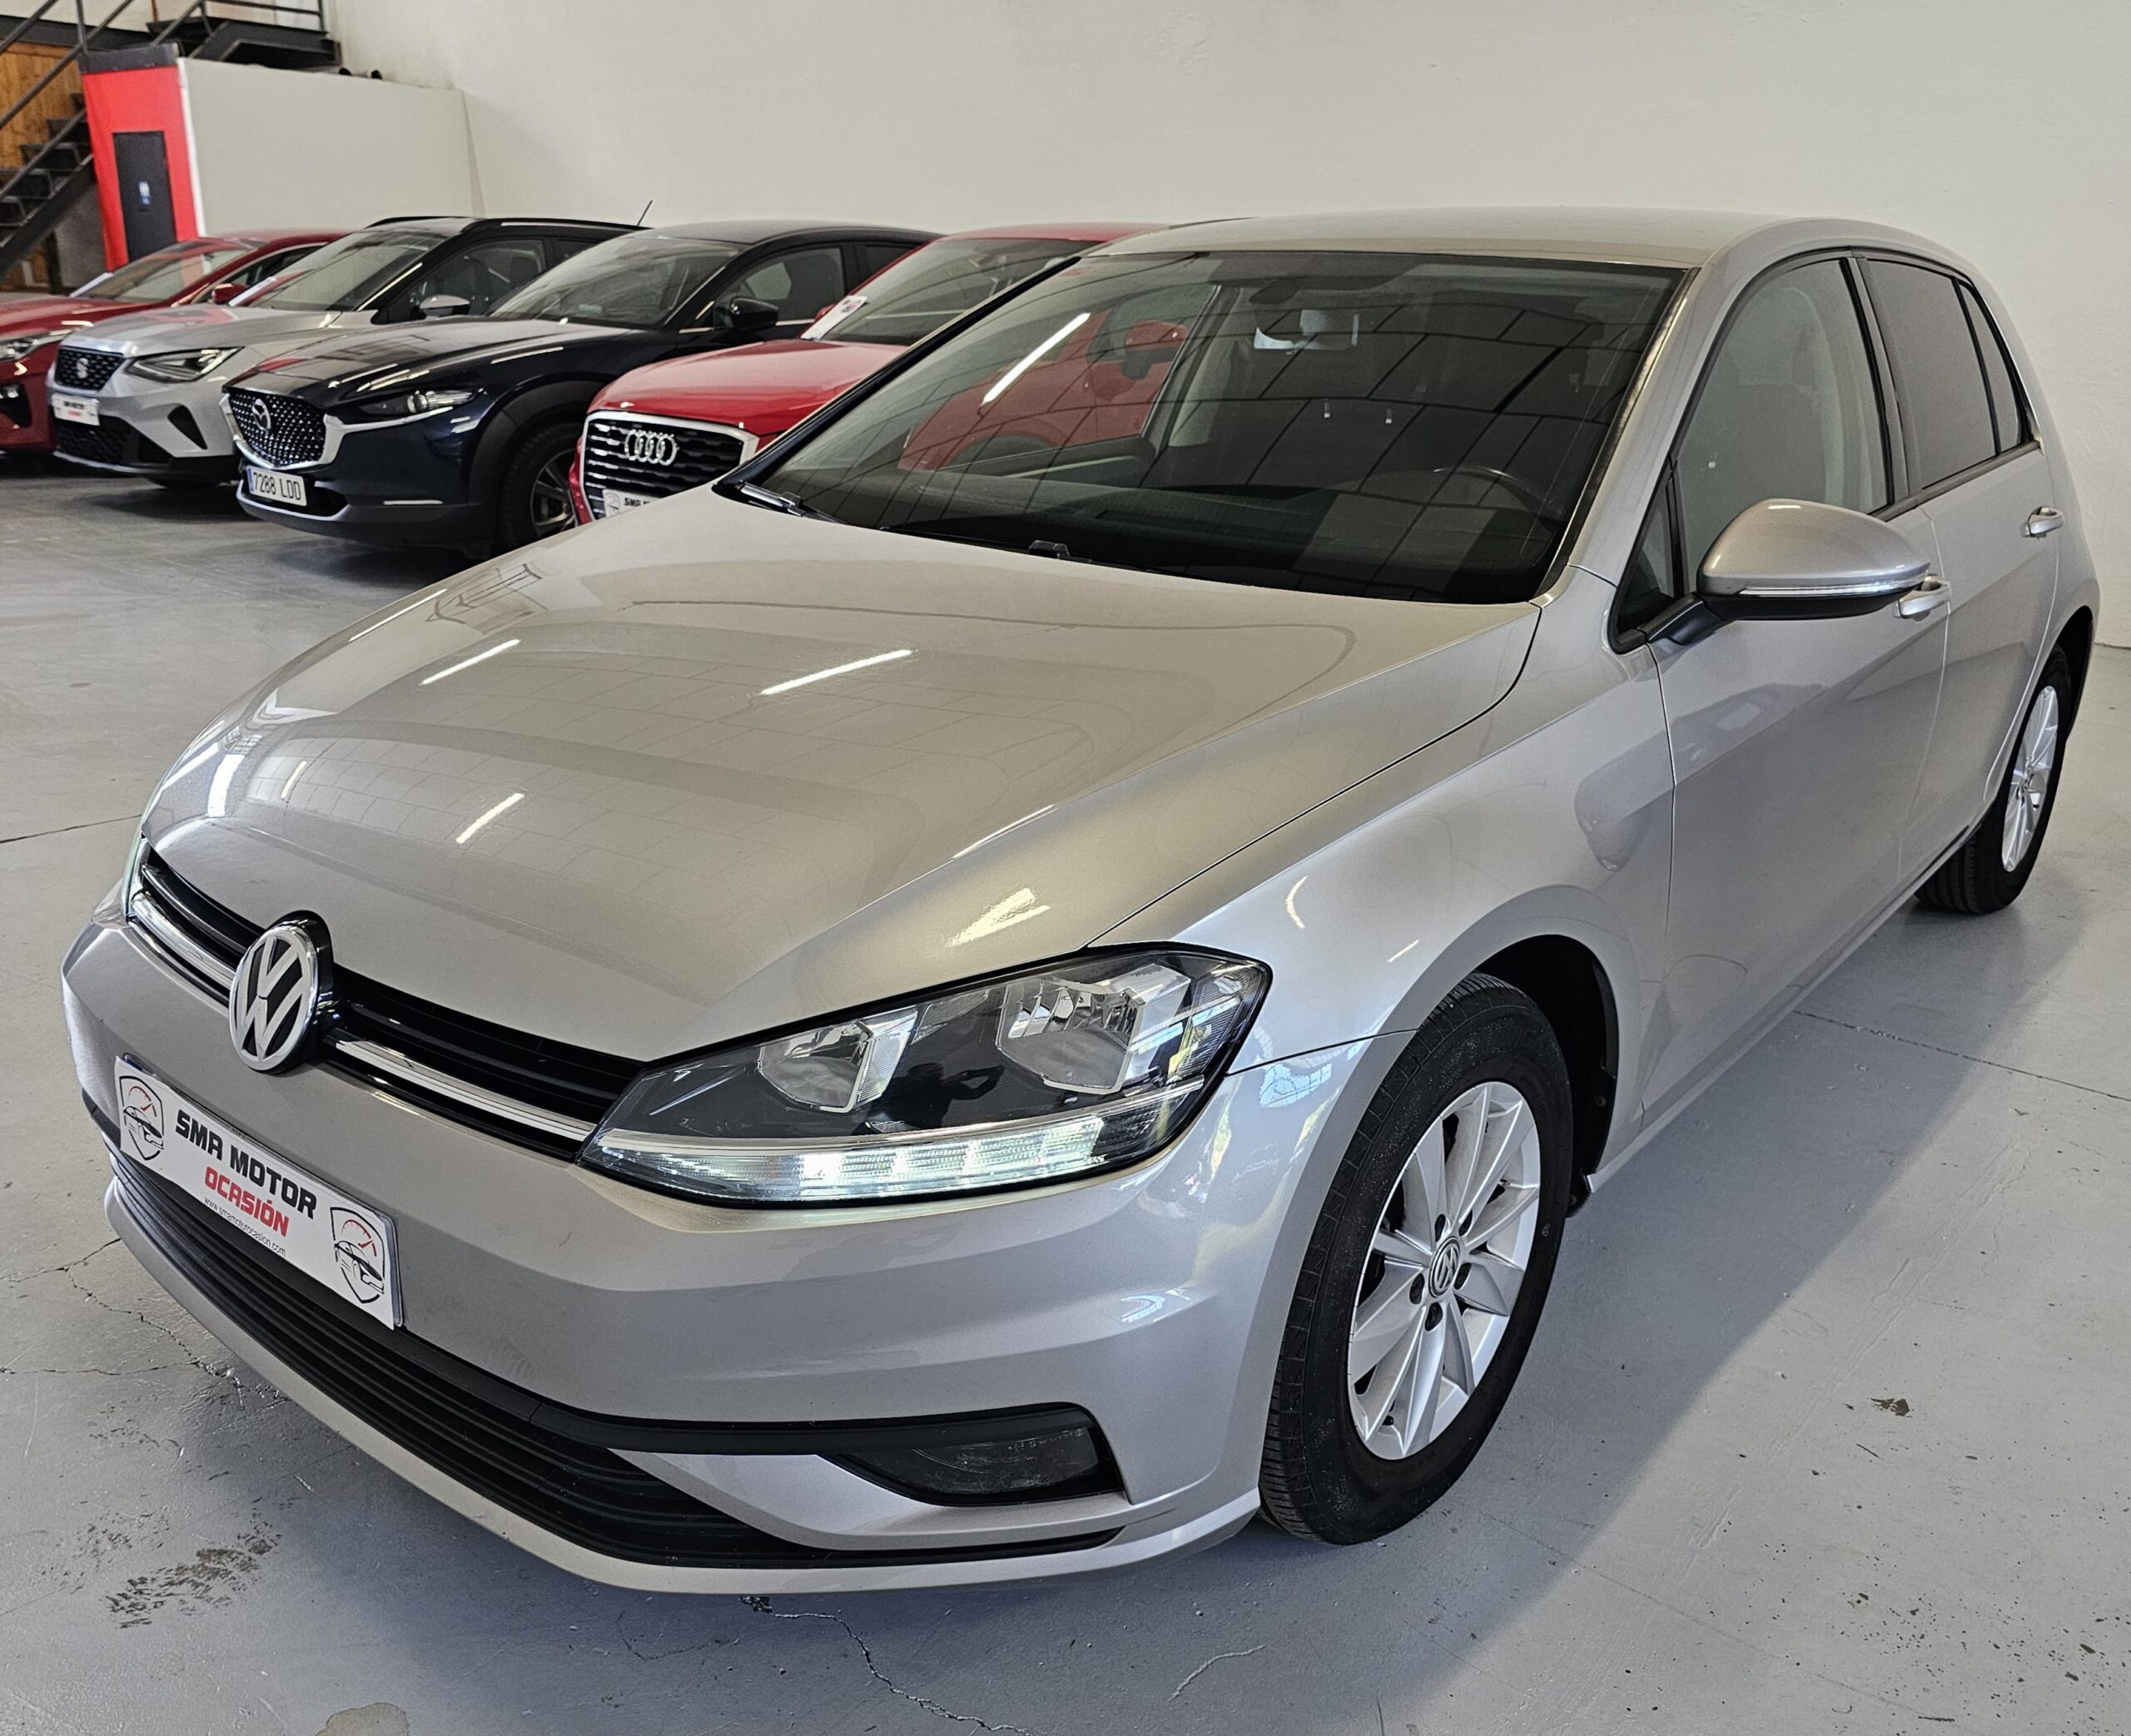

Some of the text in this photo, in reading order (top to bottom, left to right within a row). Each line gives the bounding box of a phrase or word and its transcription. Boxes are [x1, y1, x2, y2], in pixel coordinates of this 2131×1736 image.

[254, 472, 301, 500] 7288 LDD
[176, 1109, 317, 1220] SMA MOTOR
[204, 1197, 286, 1257] www.smamotorocasion.com
[205, 1166, 290, 1237] OCASIÓN
